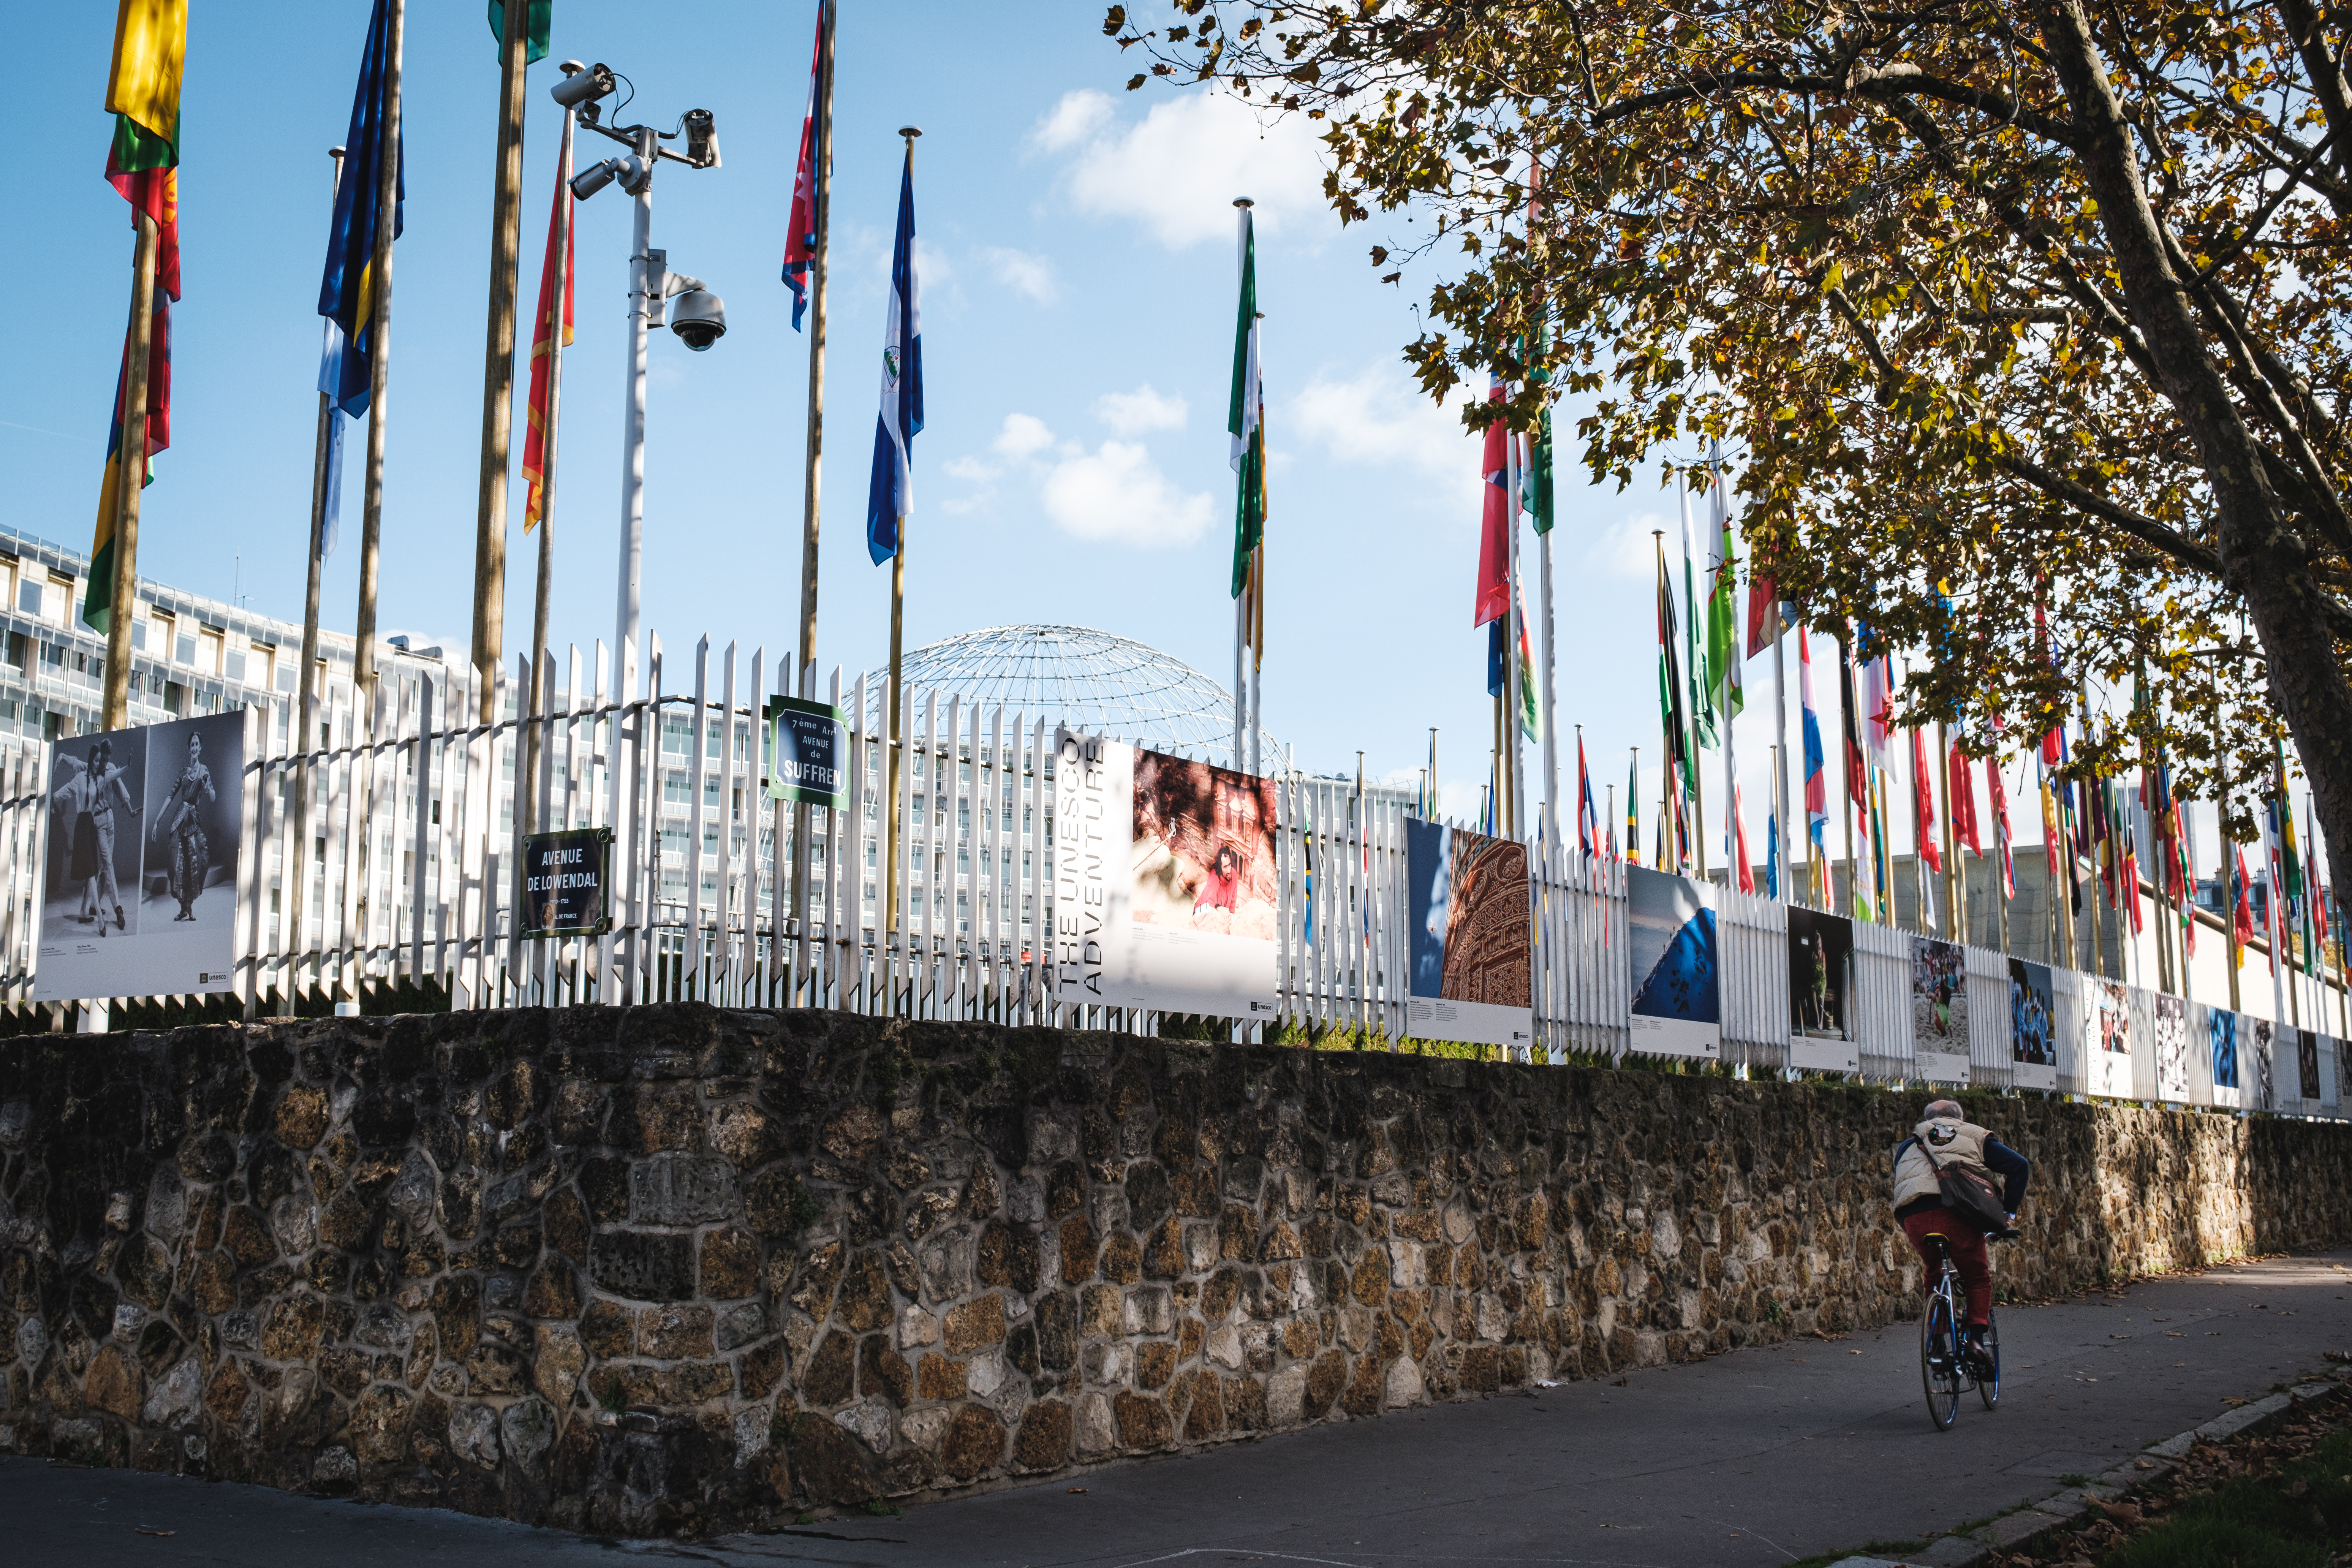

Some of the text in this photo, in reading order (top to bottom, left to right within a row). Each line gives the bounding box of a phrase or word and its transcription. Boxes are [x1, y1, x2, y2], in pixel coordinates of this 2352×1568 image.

[803, 736, 829, 748] AVENUE
[811, 750, 821, 758] de
[784, 759, 841, 786] SUFFREN
[542, 848, 582, 866] AVENUE
[1059, 737, 1081, 993] THE UNESCO
[1084, 742, 1103, 996] ADVENTURE
[528, 872, 598, 891] DE LOWENDAL
